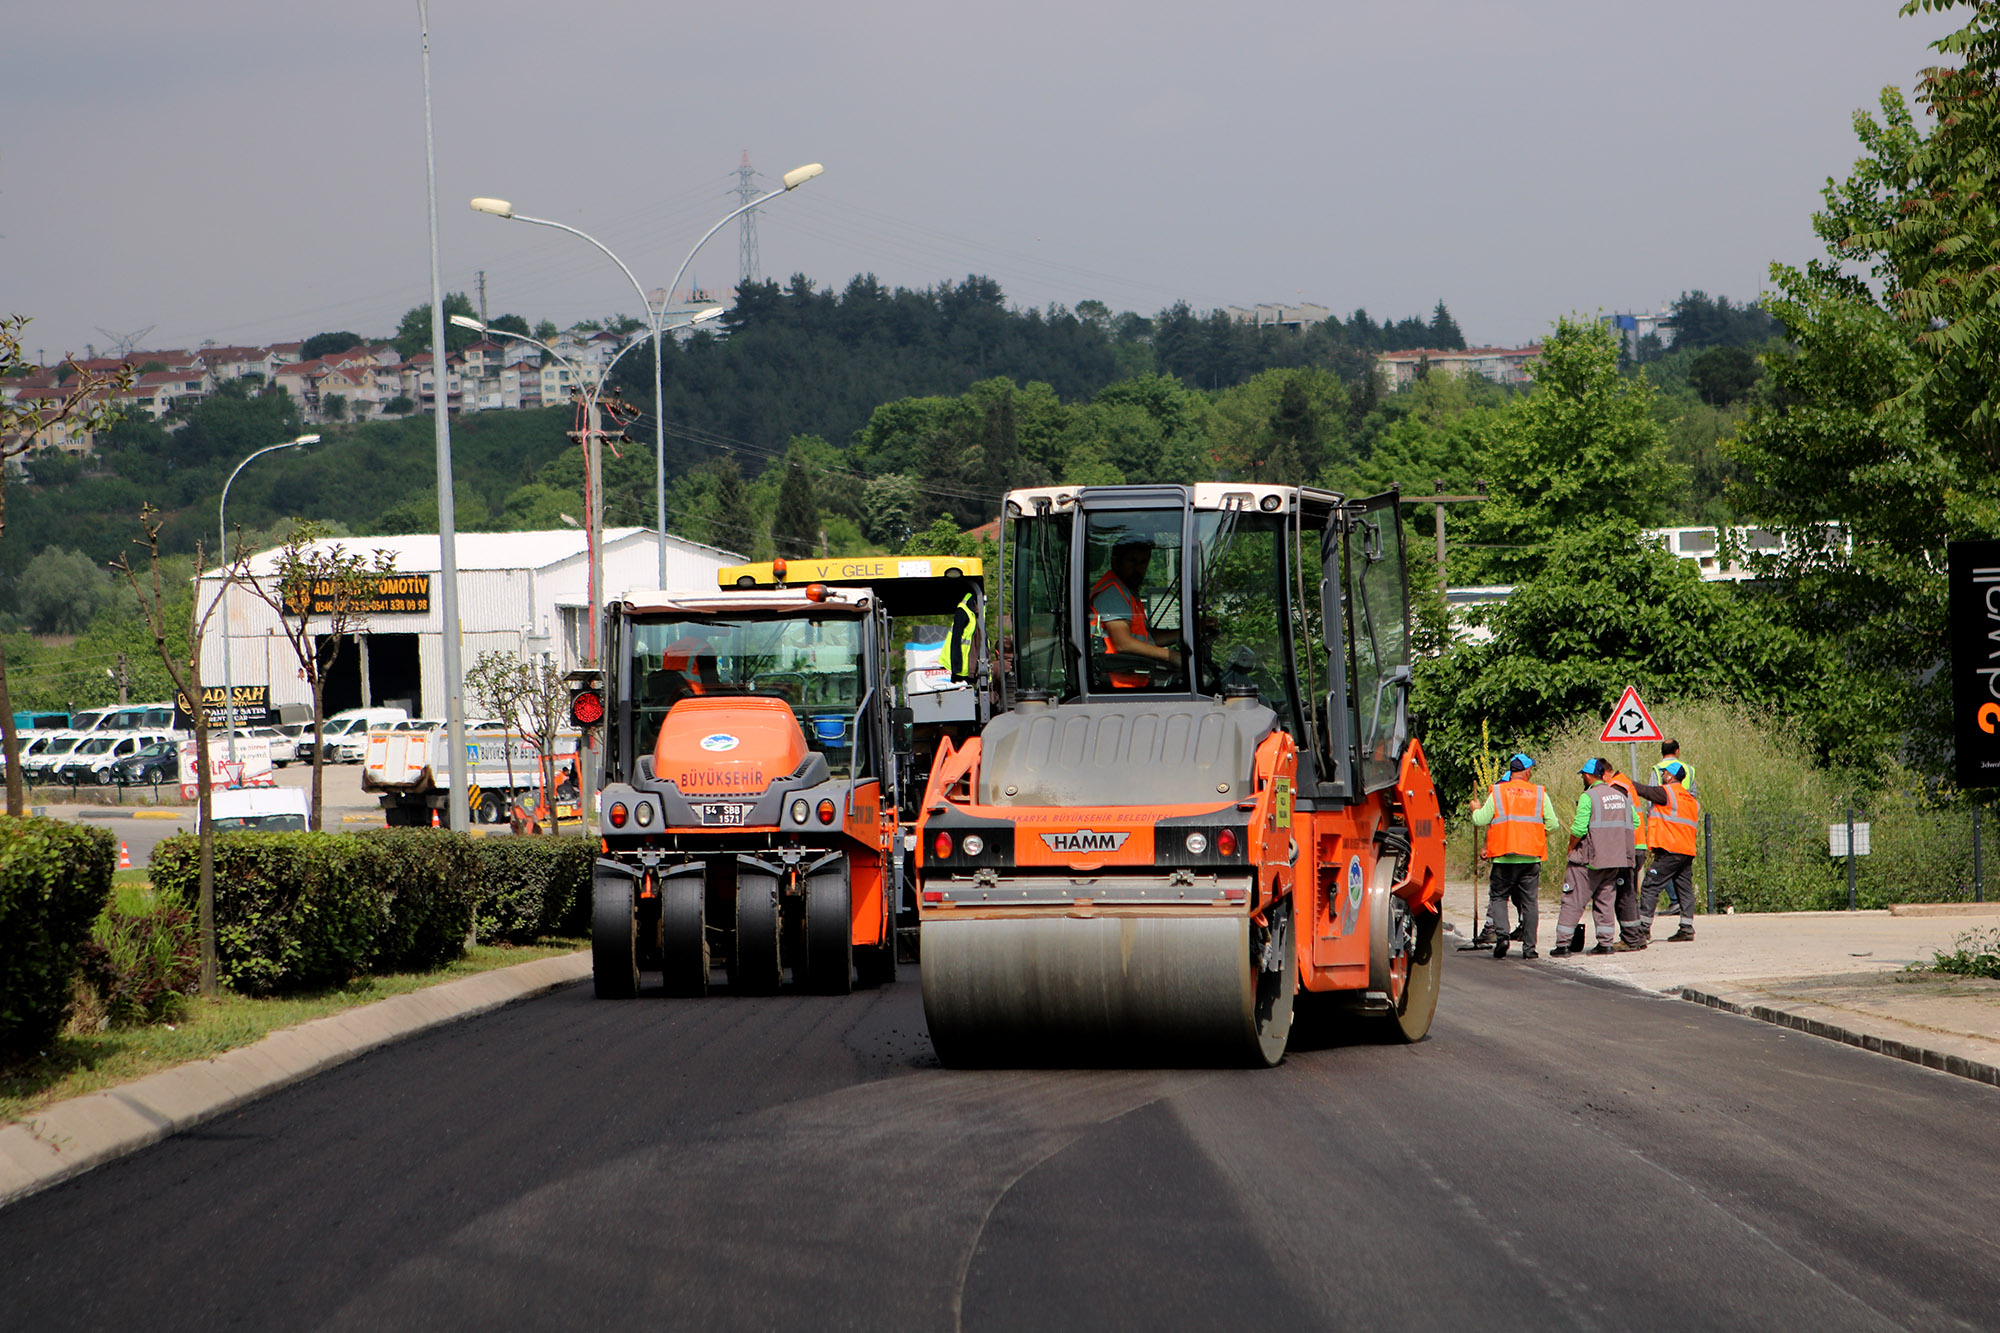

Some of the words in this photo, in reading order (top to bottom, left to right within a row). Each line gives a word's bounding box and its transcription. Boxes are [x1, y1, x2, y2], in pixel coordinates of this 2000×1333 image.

[417, 599, 428, 610] 98
[681, 768, 763, 787] BÜYÜKŞEHİR
[705, 806, 717, 815] 54
[723, 805, 740, 815] SBB
[719, 814, 740, 823] 1571
[1053, 812, 1112, 823] BÜYÜKŞEHİR
[1054, 834, 1116, 850] HAMM
